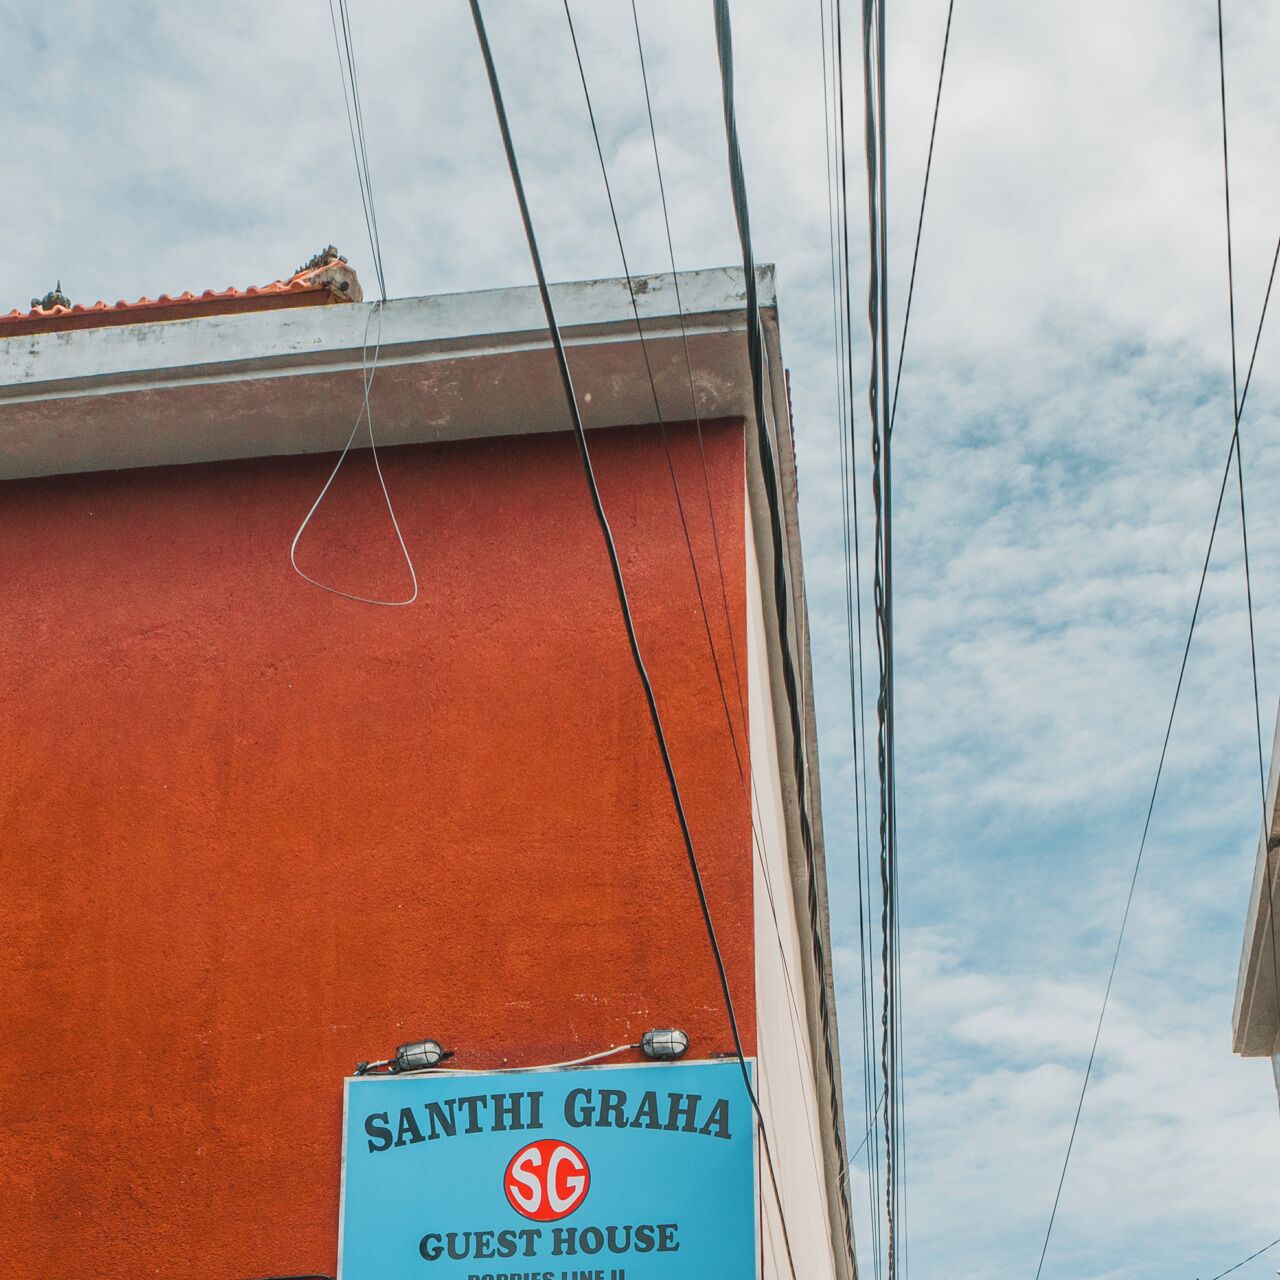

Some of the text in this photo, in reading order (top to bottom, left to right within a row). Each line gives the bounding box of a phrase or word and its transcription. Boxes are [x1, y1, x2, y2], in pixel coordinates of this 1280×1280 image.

[363, 1088, 733, 1153] SANTHI GRAHA
[509, 1146, 586, 1213] SG
[419, 1223, 680, 1261] GUEST HOUSE
